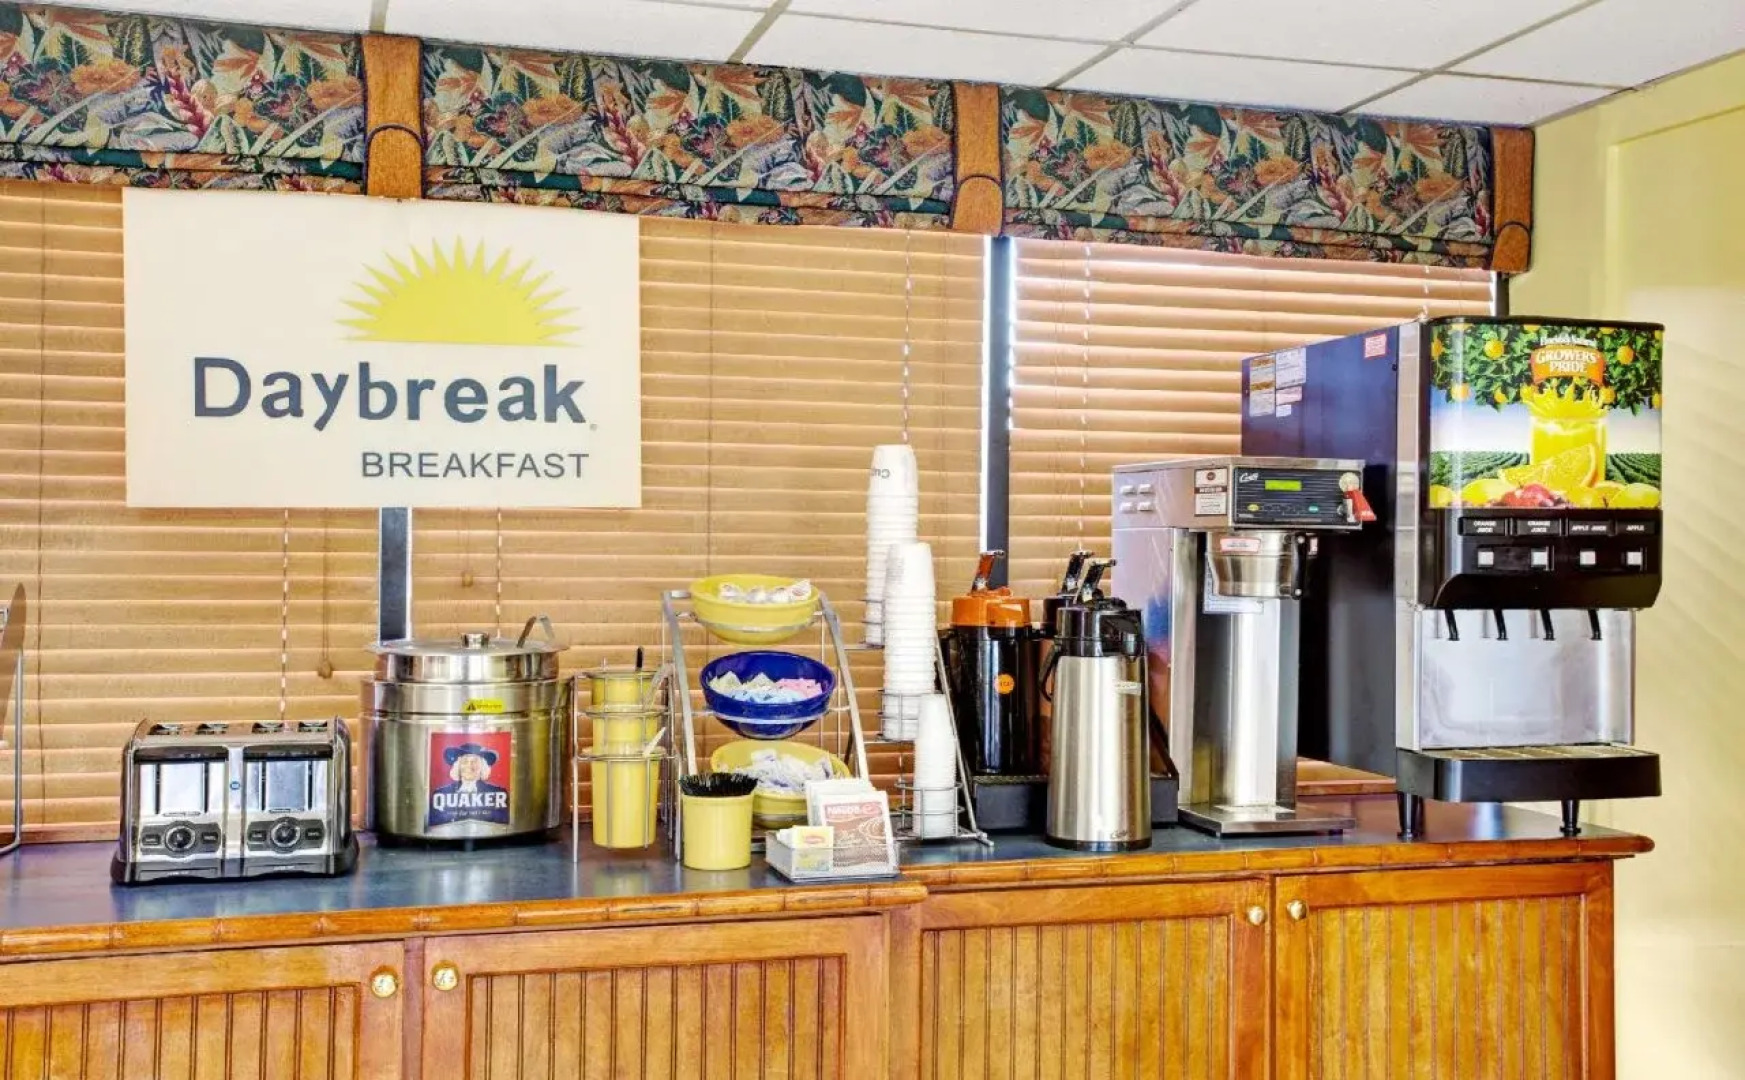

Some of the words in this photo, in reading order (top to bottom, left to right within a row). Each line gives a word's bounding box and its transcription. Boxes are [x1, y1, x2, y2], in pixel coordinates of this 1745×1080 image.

[194, 356, 587, 431] Daybreak
[362, 452, 589, 478] BREAKFAST
[432, 792, 508, 811] QUAKER
